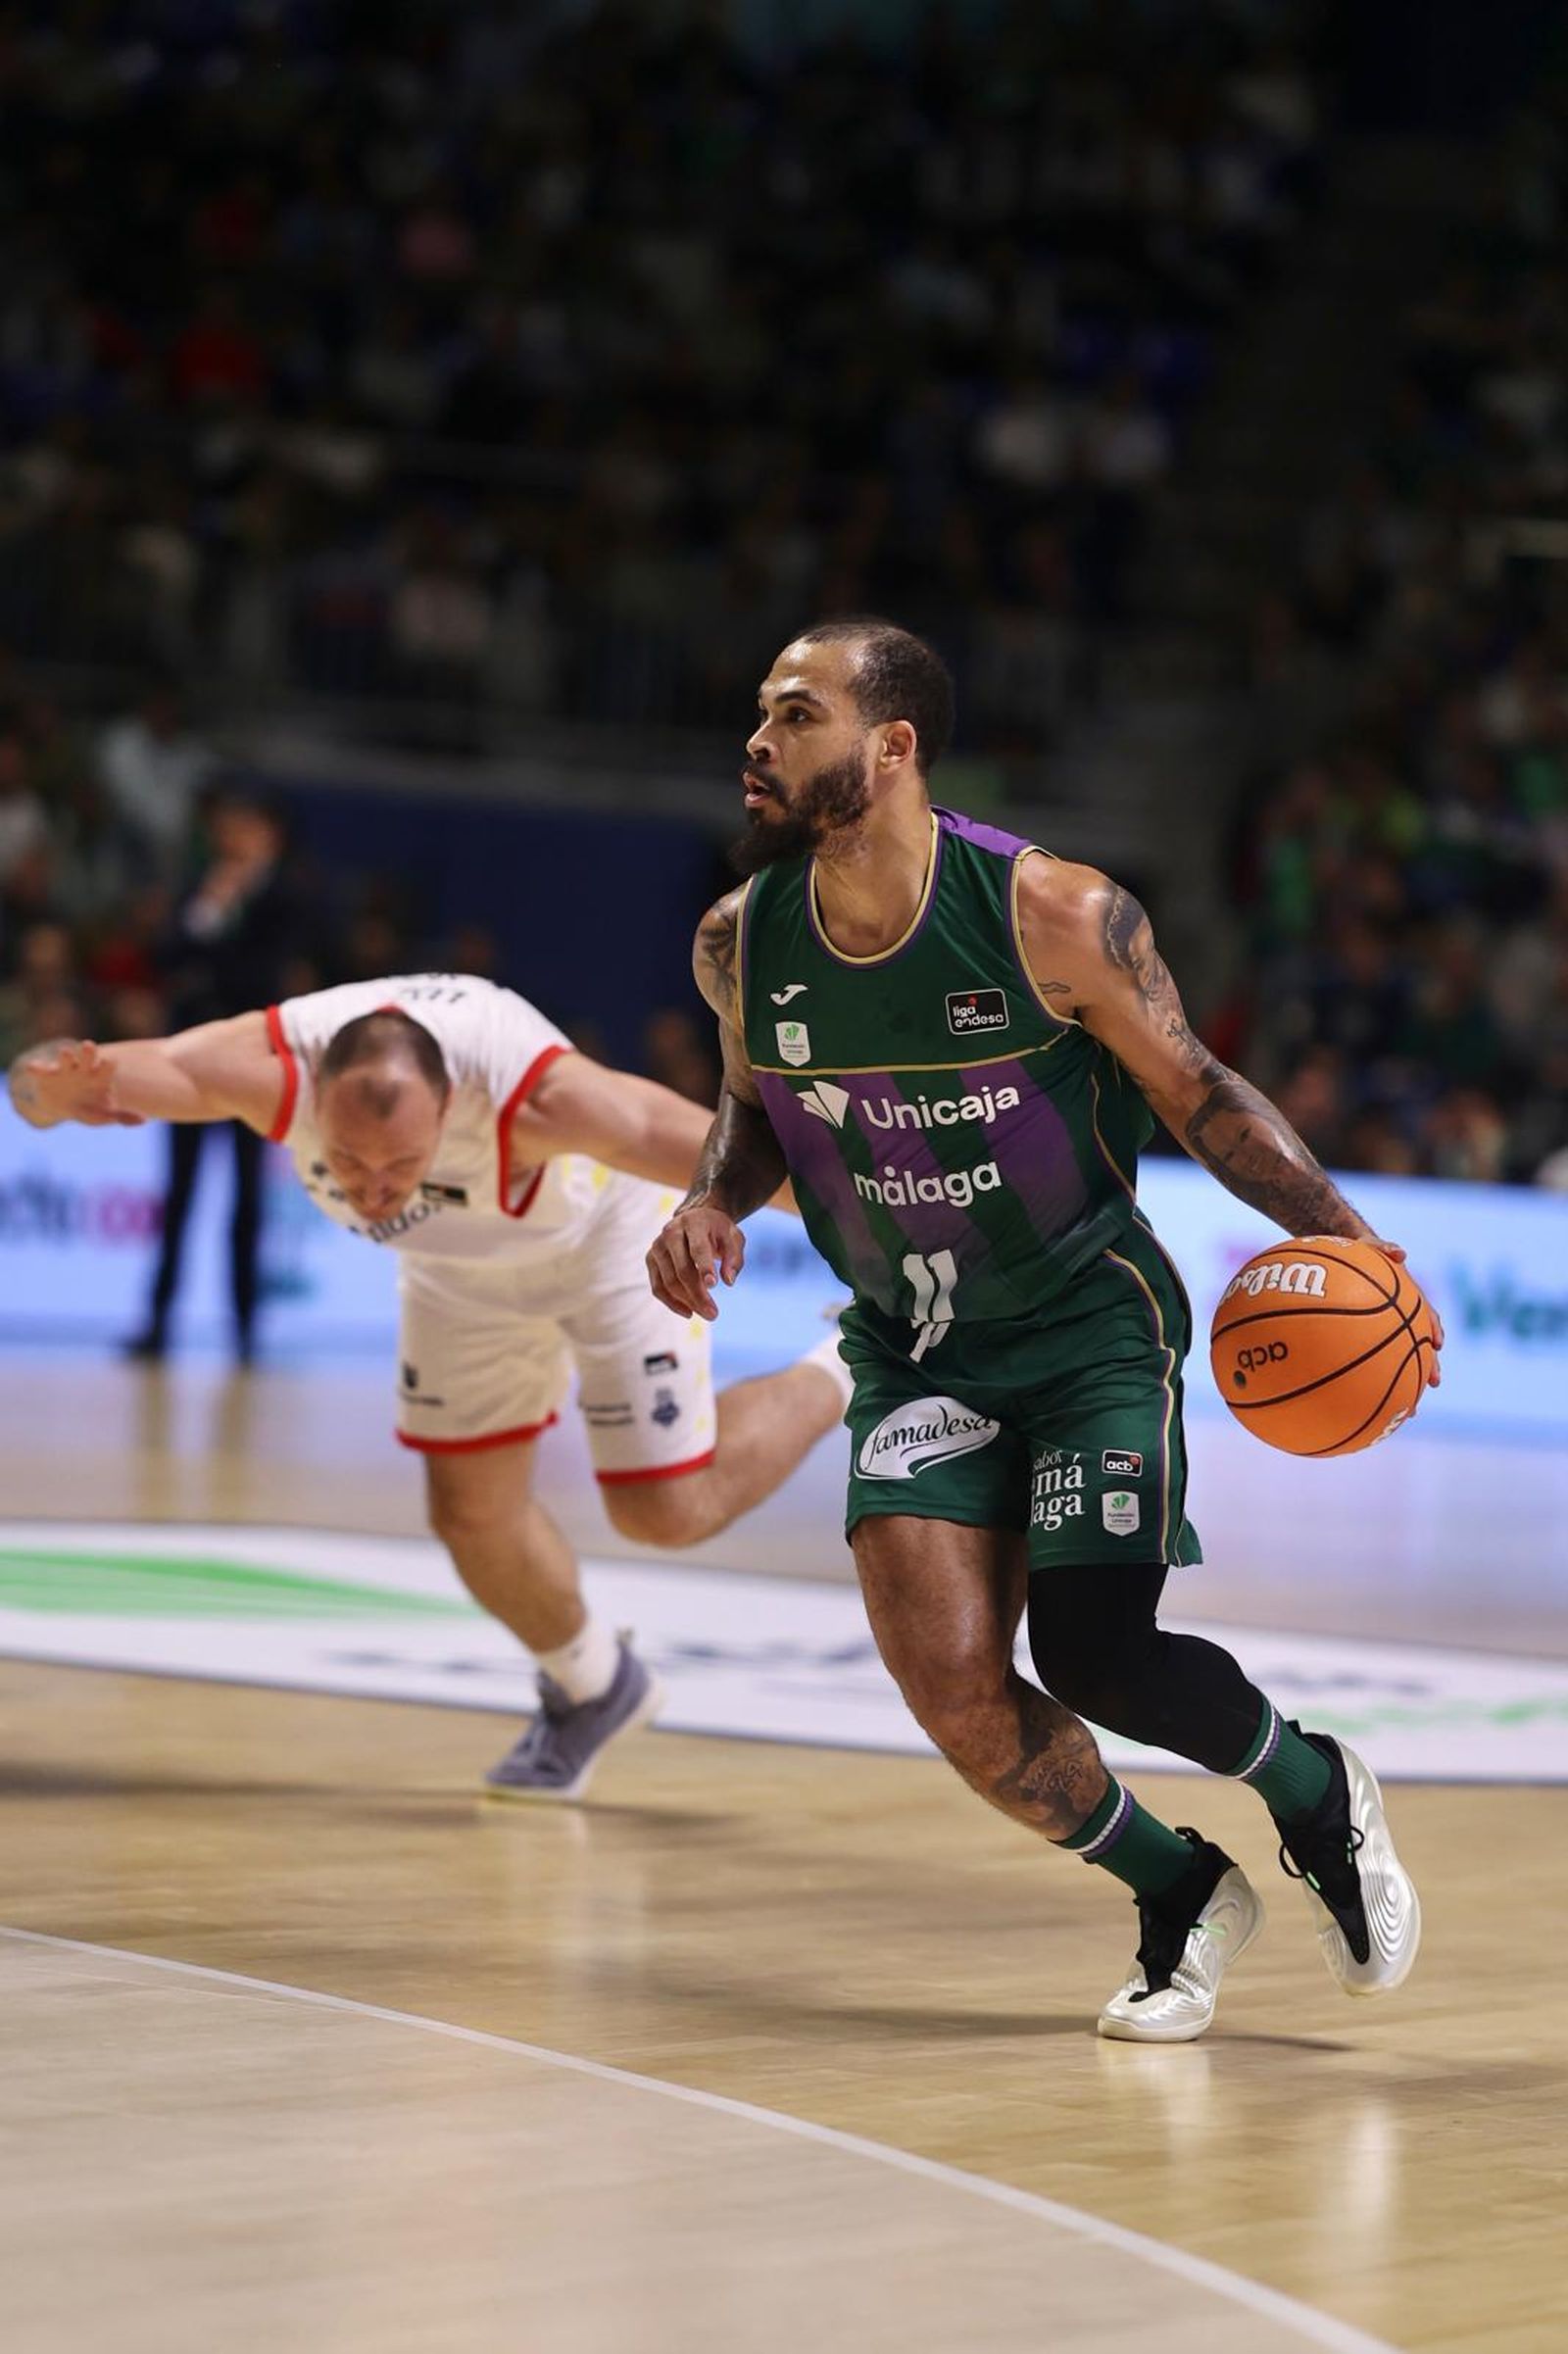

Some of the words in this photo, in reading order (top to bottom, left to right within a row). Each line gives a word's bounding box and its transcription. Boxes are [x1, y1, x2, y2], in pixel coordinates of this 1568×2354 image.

[953, 1005, 976, 1018] liga
[955, 1013, 1004, 1028] endesa
[860, 1086, 1020, 1130] Unicaja
[1218, 1261, 1327, 1305] Wilso
[1237, 1341, 1289, 1372] acb
[863, 1403, 993, 1470] famadesa
[1032, 1449, 1063, 1471] abor
[1105, 1458, 1134, 1472] acb
